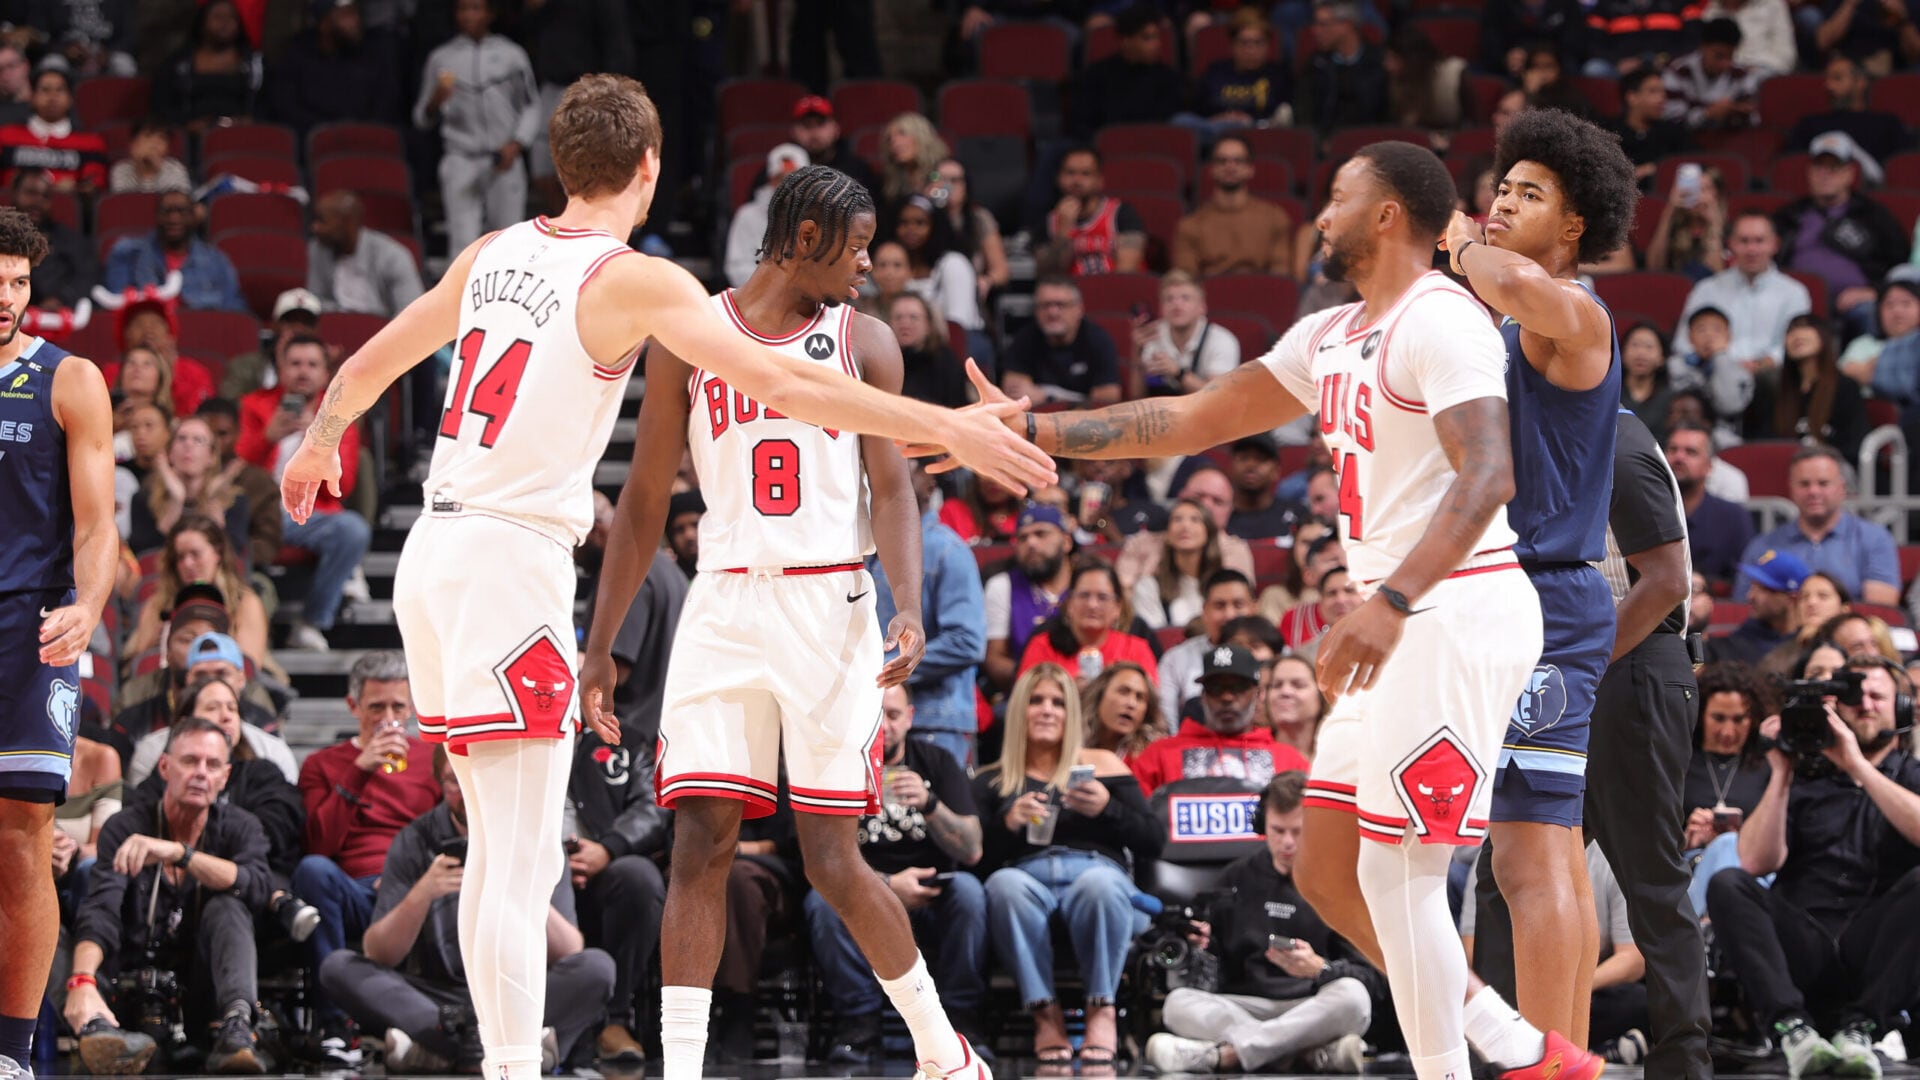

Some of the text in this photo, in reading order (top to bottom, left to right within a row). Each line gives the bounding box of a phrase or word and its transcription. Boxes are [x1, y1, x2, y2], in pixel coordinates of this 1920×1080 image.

[471, 269, 561, 328] BUZELIS
[0, 391, 34, 400] Robinhood
[439, 326, 534, 449] 14
[752, 438, 801, 517] 8
[1189, 802, 1246, 835] USO
